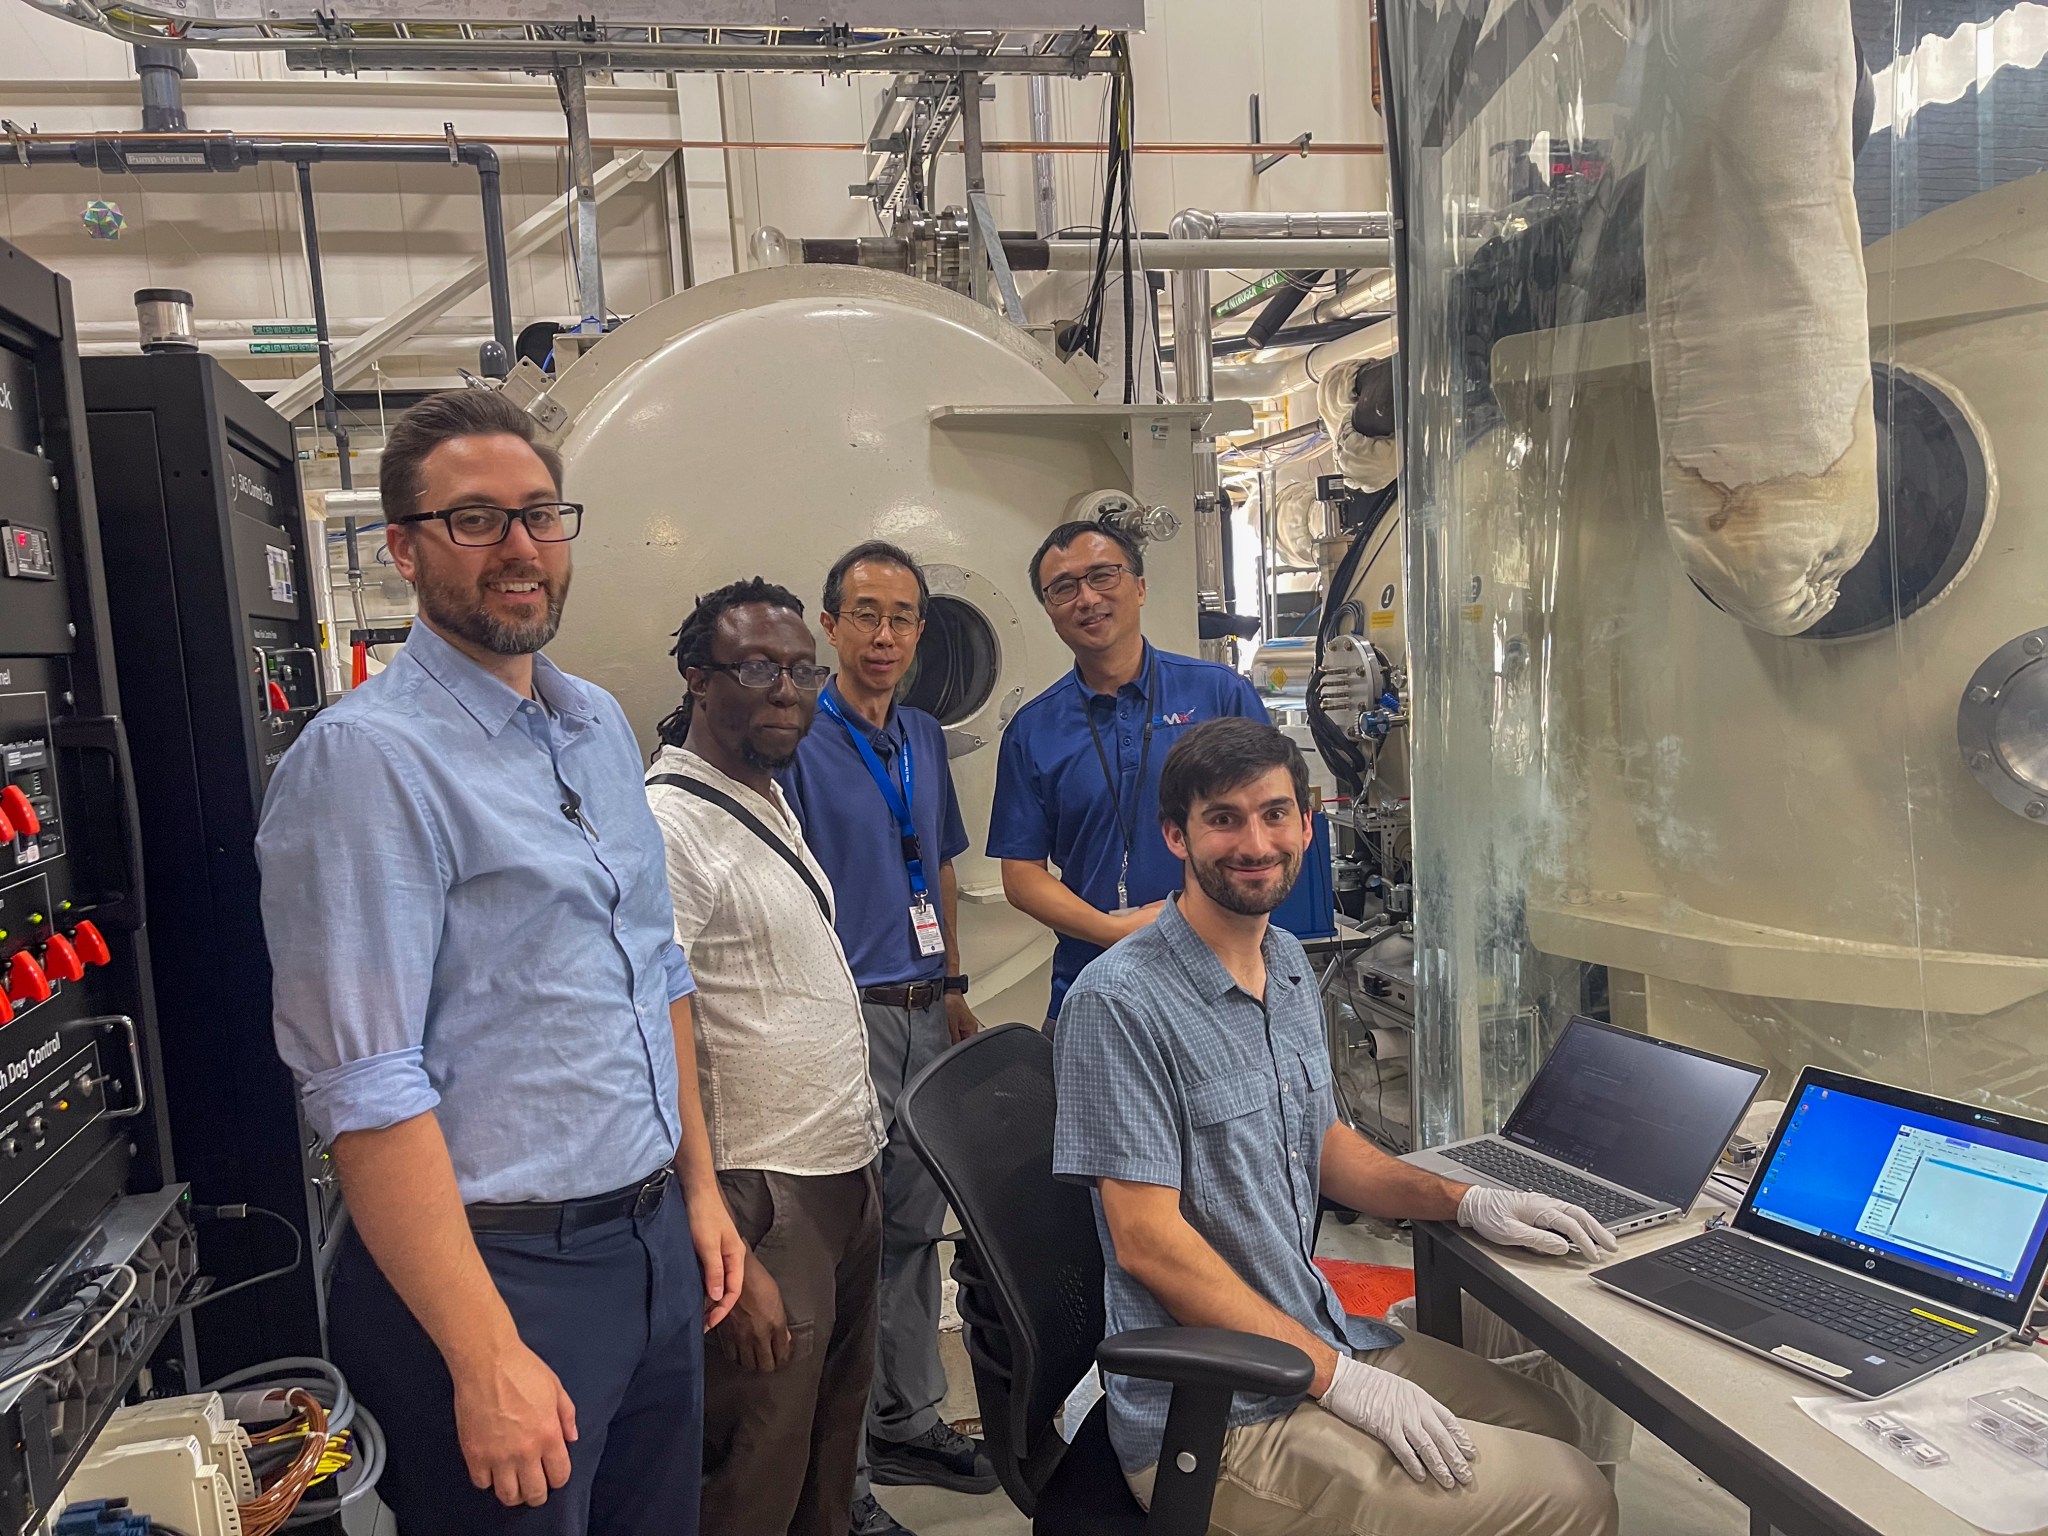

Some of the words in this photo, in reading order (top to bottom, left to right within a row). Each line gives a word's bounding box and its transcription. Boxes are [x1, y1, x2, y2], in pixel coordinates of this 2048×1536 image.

[128, 155, 156, 165] Pump
[159, 155, 180, 163] Vent
[182, 155, 204, 163] Line
[1228, 284, 1258, 309] NITROGEN
[1261, 272, 1279, 289] VENT
[273, 326, 291, 334] WATER
[291, 326, 311, 334] SUPPLY
[260, 344, 281, 353] CHILLED
[280, 344, 298, 352] WATER
[7, 1058, 29, 1084] Dog
[28, 1031, 61, 1069] Control
